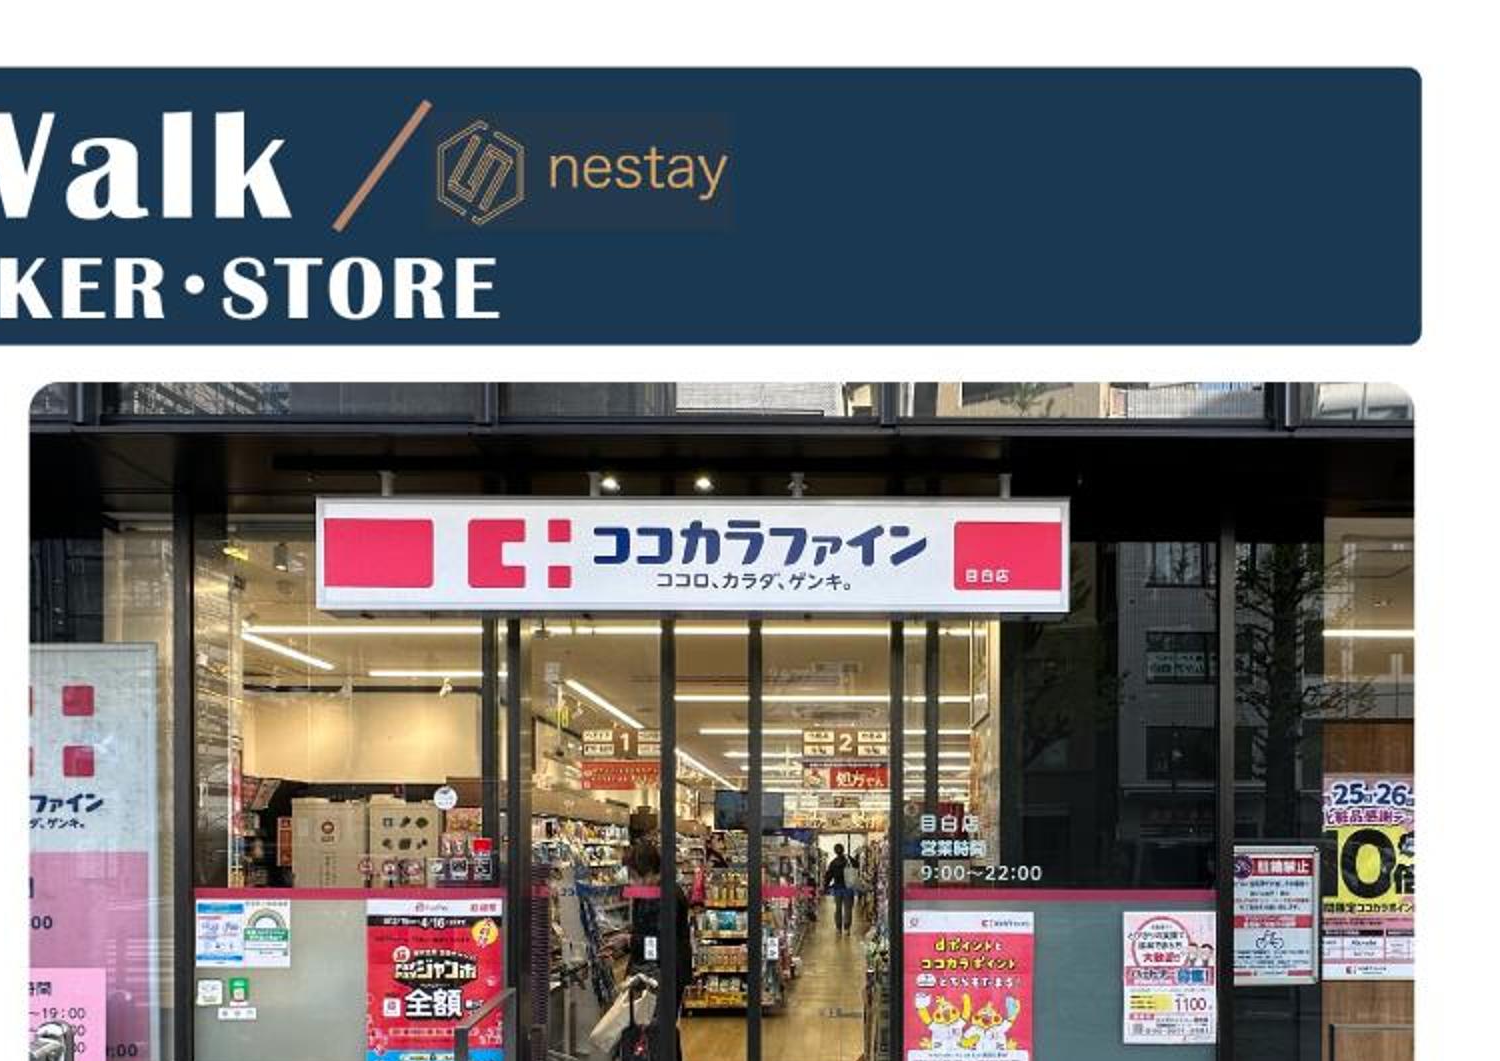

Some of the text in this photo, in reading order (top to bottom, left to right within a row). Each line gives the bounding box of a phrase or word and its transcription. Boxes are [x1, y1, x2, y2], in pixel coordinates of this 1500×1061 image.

[593, 519, 927, 566] ココカラファイン
[839, 733, 853, 752] 2
[920, 814, 980, 833] 目白店
[920, 840, 987, 857] 営業時間
[405, 988, 463, 1012] 全額
[1175, 997, 1206, 1012] 1100
